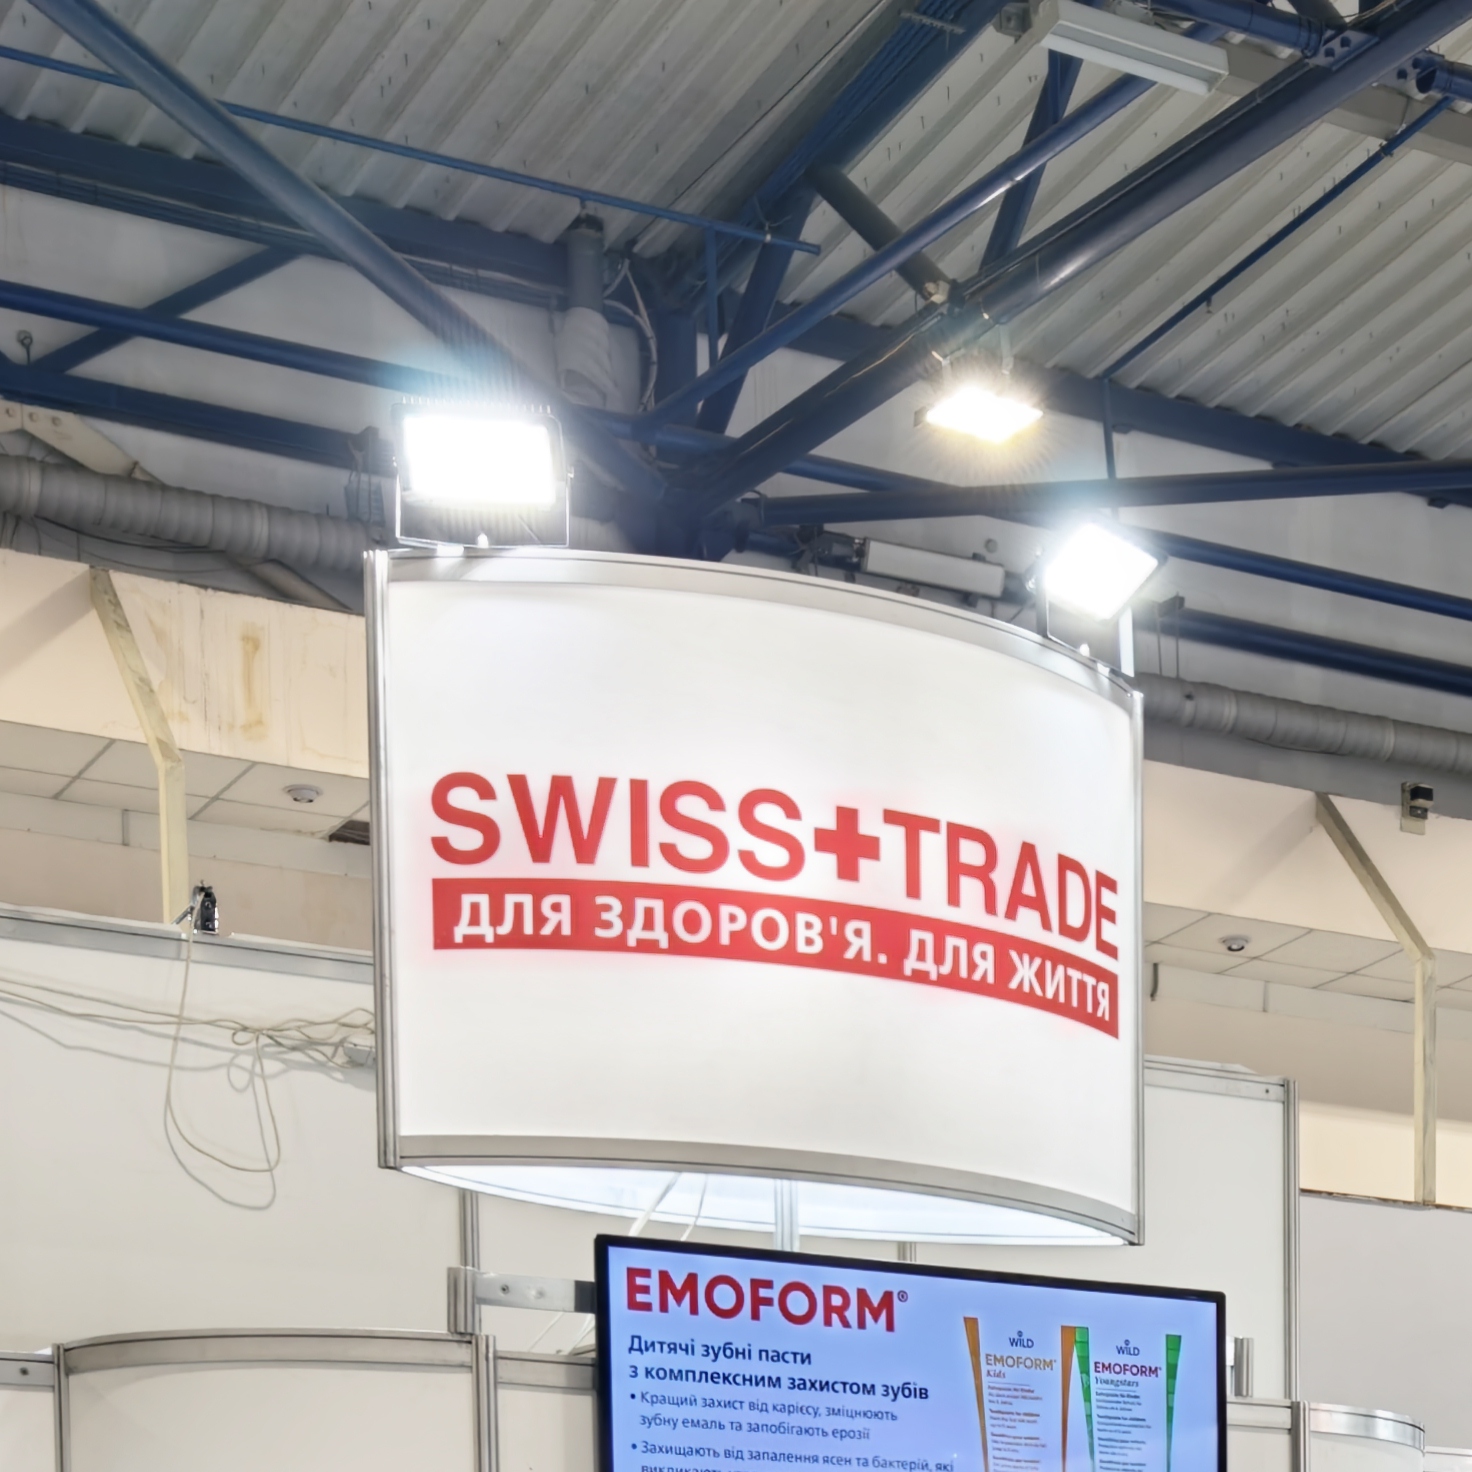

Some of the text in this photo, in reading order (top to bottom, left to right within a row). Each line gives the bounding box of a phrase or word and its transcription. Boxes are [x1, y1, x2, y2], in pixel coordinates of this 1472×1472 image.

[454, 892, 572, 945] ДЛЯ
[904, 931, 996, 986] ДЛЯ
[1008, 949, 1110, 1022] ЖИТТЯ
[629, 1335, 812, 1365] Дитячі зубні пасти
[1009, 1337, 1034, 1348] WILD
[1116, 1346, 1140, 1356] WILD
[629, 1365, 929, 1401] з комплексним захистом зубів
[986, 1370, 1006, 1379] Kids
[640, 1392, 697, 1407] Кращий
[701, 1397, 745, 1410] захист
[748, 1398, 769, 1413] від
[825, 1406, 898, 1421] зміцнюють
[639, 1414, 870, 1440] зубну емаль та запобігають ерозії
[641, 1441, 720, 1458] Захищають
[724, 1448, 744, 1461] від
[747, 1450, 819, 1465] запалення
[822, 1455, 852, 1466] ясен
[856, 1457, 869, 1467] та
[935, 1460, 954, 1472] які
